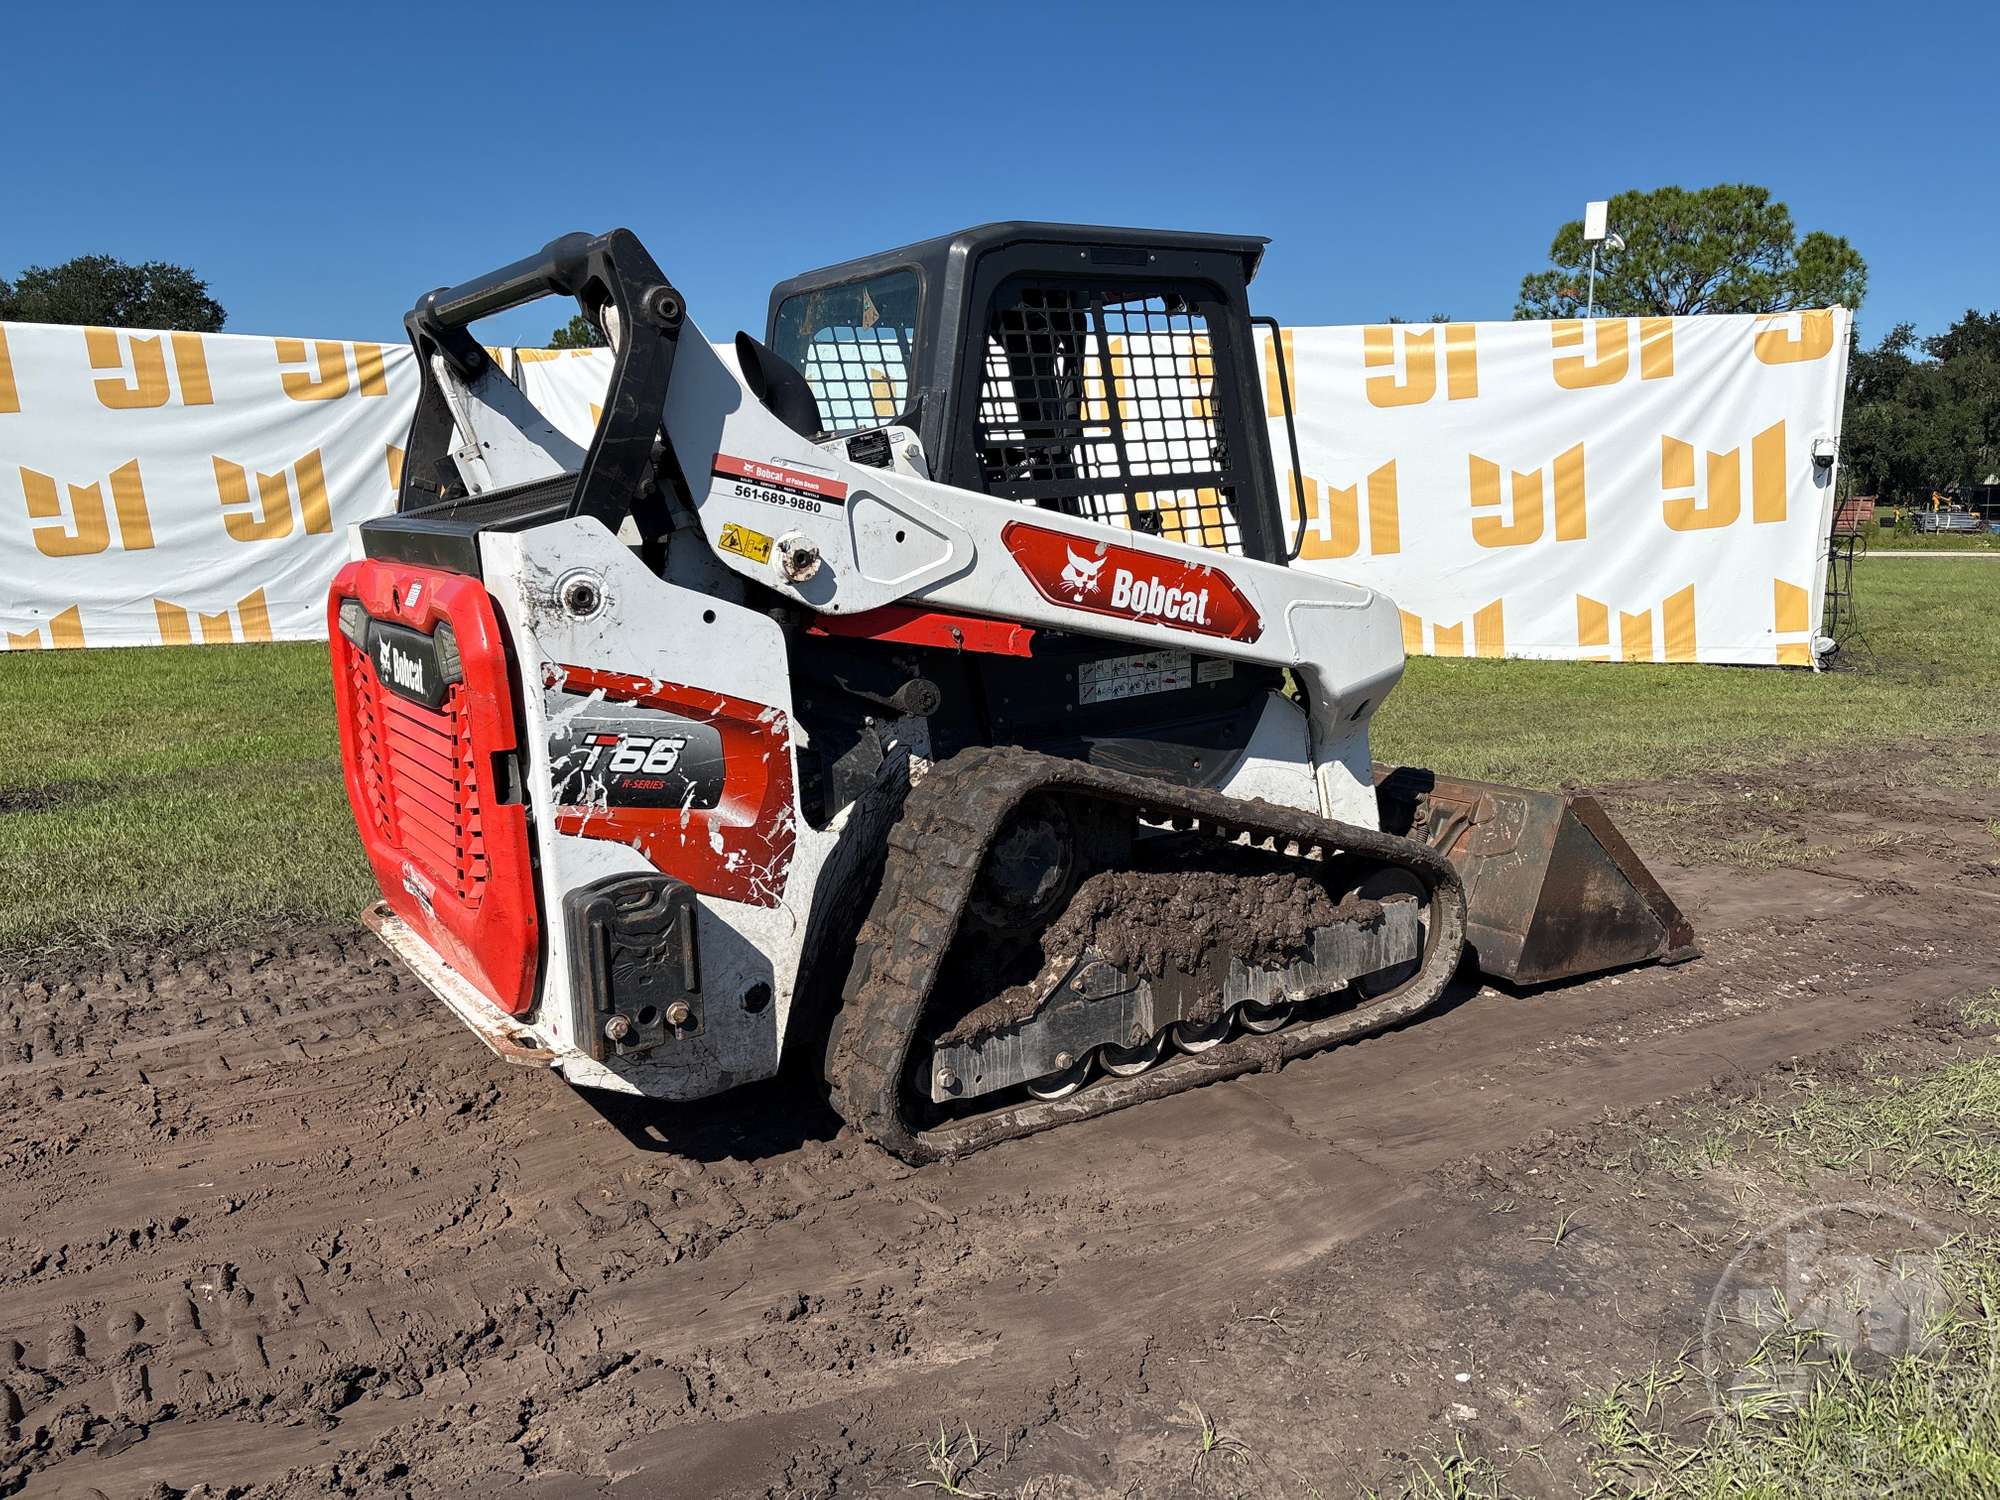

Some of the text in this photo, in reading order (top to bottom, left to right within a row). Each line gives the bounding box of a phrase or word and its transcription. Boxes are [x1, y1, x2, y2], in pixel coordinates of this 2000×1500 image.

[756, 467, 783, 482] Bobcat
[735, 485, 821, 513] 561-689-9880
[1110, 568, 1210, 625] Bobcat
[392, 647, 425, 695] Bobcat
[580, 732, 687, 776] T66
[622, 778, 667, 791] R-SERIES
